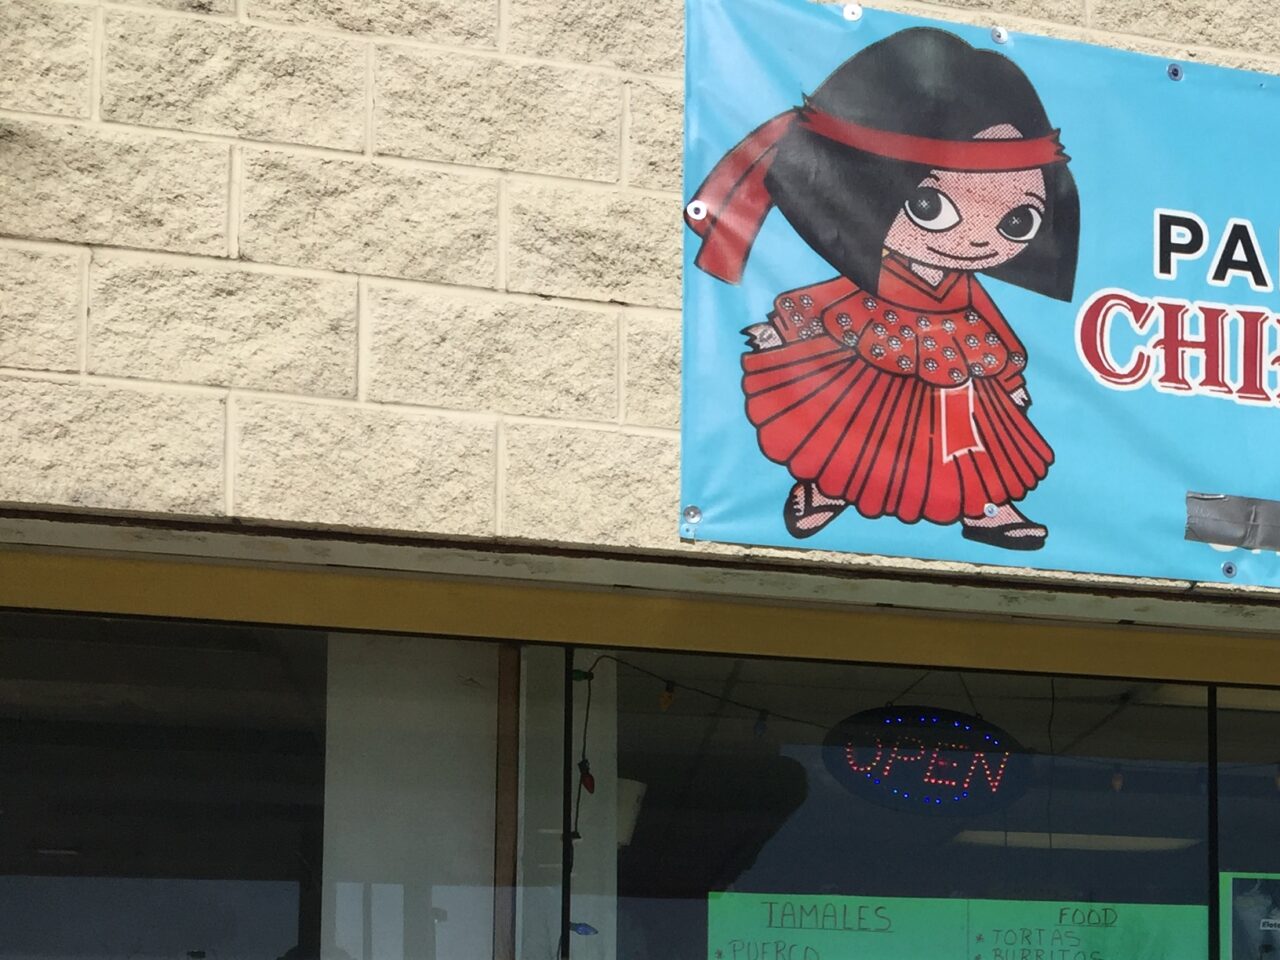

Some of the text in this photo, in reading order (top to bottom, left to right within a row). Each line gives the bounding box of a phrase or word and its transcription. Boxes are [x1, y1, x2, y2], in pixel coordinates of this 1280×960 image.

[845, 732, 1010, 792] OPEN
[761, 901, 893, 932] TAMALES
[1058, 907, 1118, 927] FOOD
[992, 928, 1081, 948] TORTAS
